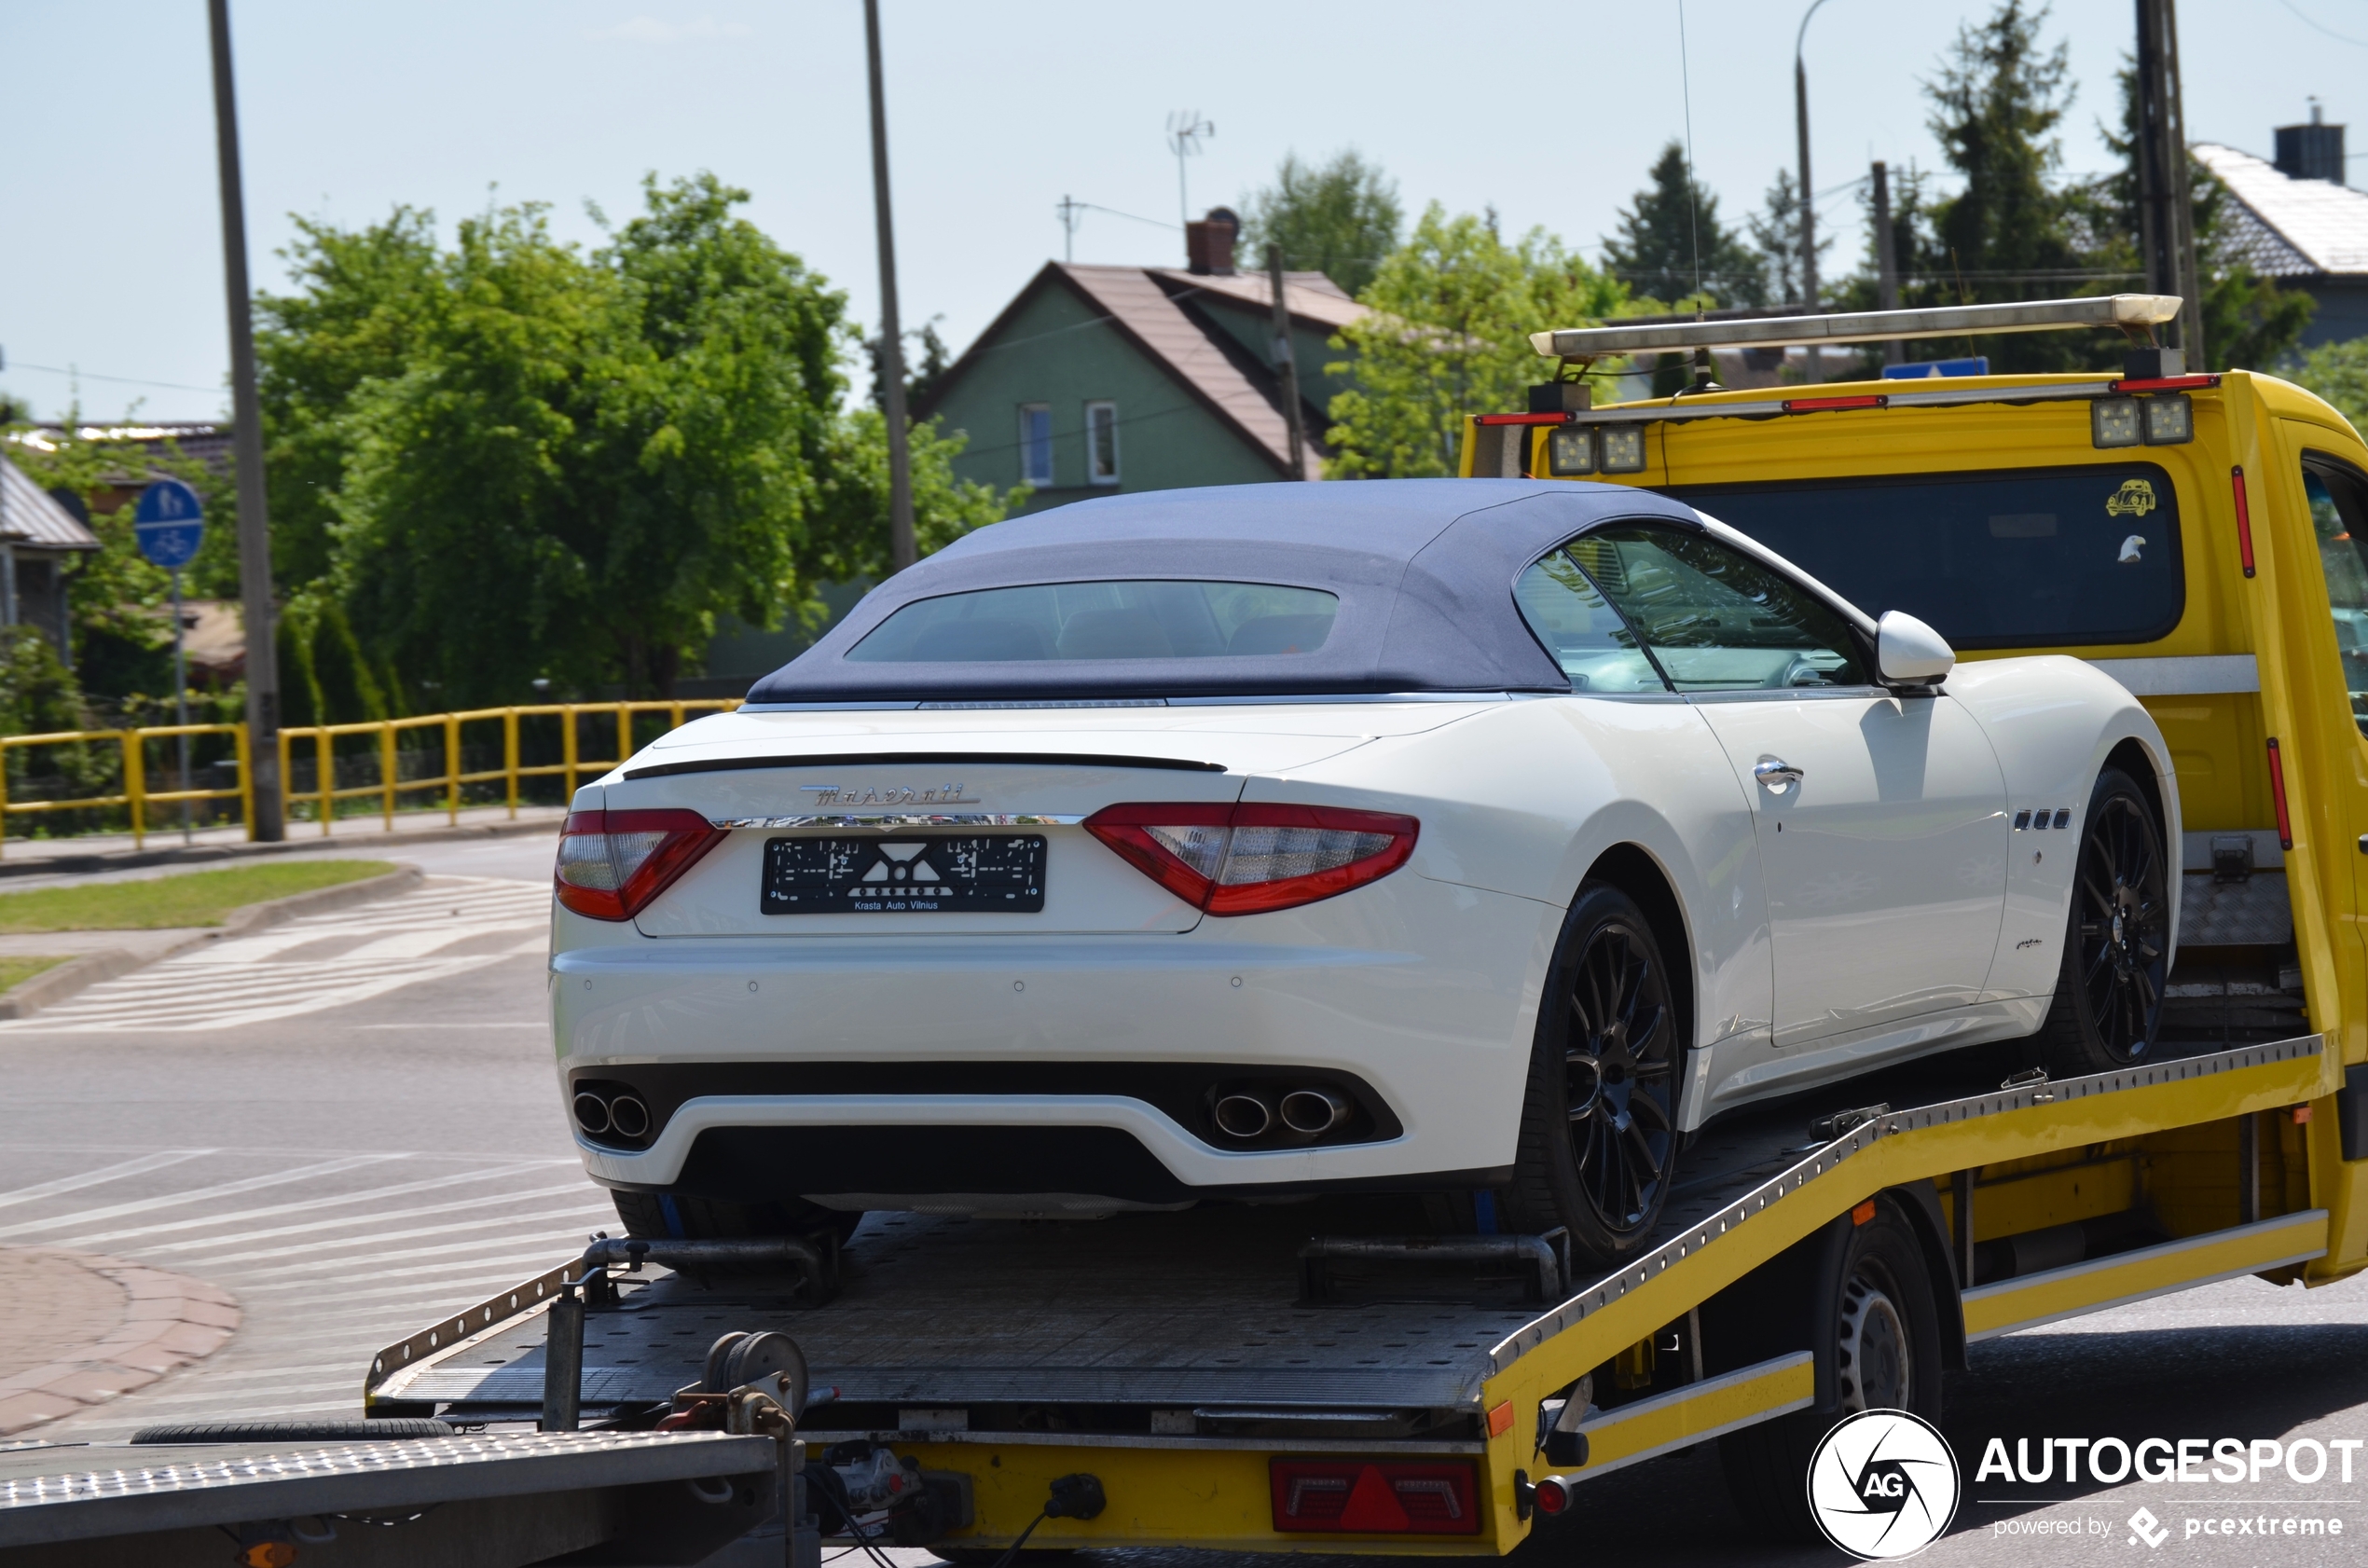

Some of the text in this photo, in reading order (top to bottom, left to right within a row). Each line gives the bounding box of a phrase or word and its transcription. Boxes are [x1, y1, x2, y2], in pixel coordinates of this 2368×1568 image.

[800, 783, 981, 806] Maserati
[854, 901, 939, 910] Krasta Auto Vilnius
